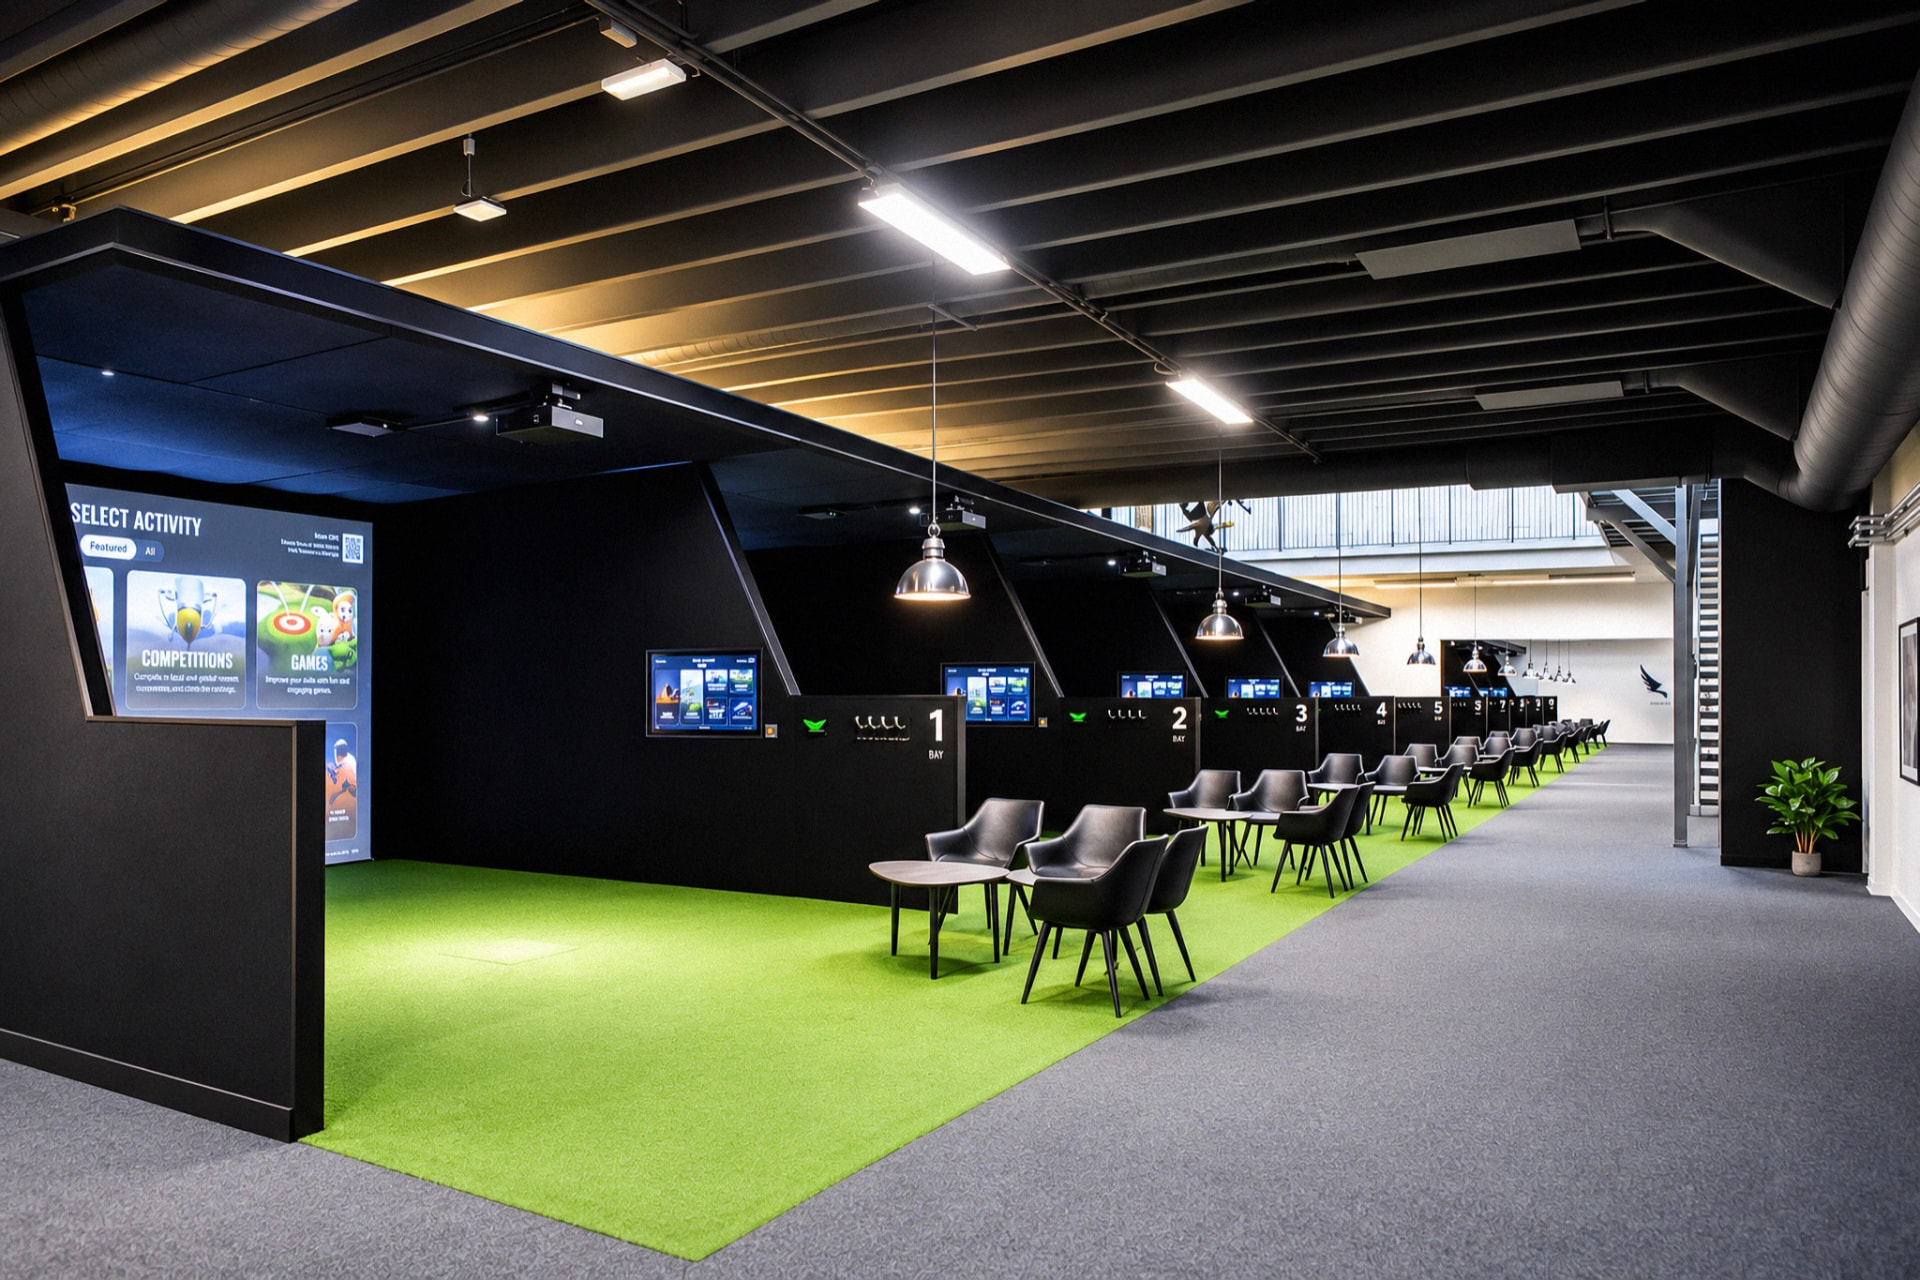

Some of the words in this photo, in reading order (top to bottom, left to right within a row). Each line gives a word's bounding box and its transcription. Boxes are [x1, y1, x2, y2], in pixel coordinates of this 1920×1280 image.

[70, 502, 129, 529] SELECT
[133, 510, 202, 537] ACTIVITY
[90, 541, 127, 553] Featured
[145, 547, 156, 556] All
[142, 649, 233, 670] COMPETITIONS
[291, 654, 328, 671] GAMES
[1295, 703, 1308, 723] 3
[1376, 701, 1388, 718] 4
[1434, 700, 1444, 714] 5
[928, 708, 943, 742] 1
[1172, 706, 1187, 730] 2
[1172, 734, 1186, 743] BAY
[928, 749, 944, 760] BAY
